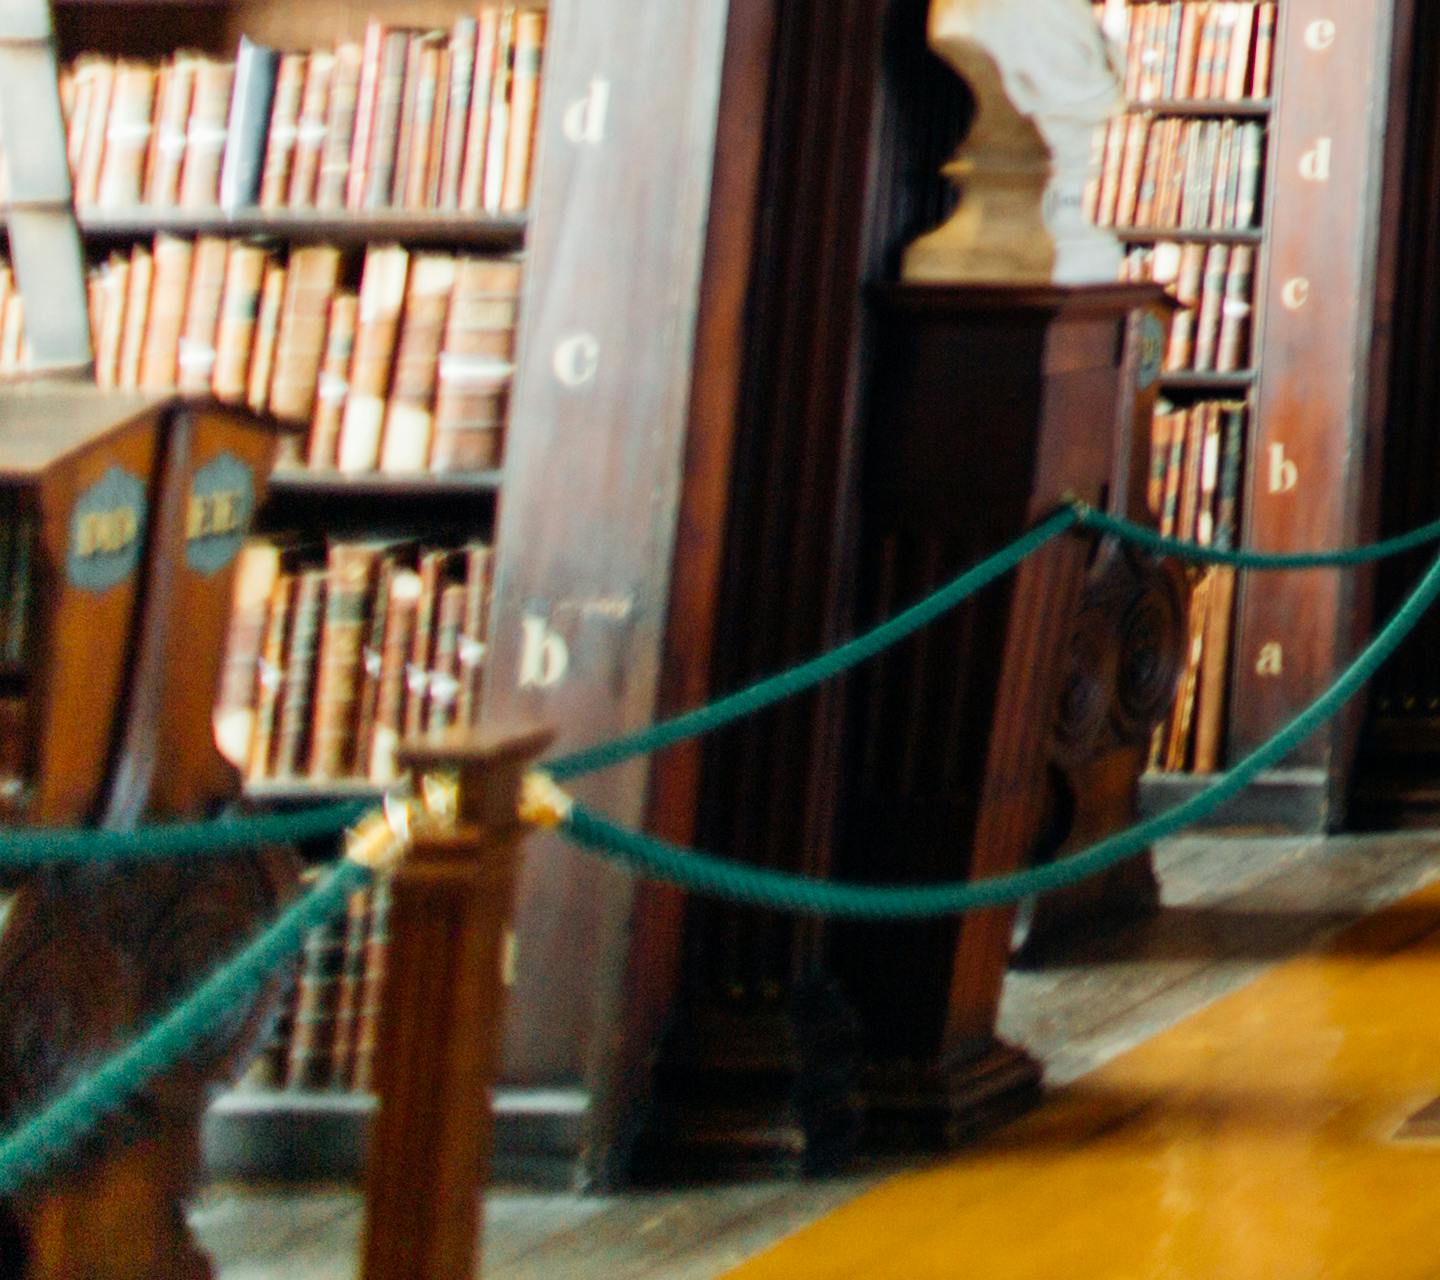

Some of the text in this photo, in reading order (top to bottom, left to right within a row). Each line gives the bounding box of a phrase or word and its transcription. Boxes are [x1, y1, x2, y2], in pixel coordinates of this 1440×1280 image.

[1304, 17, 1335, 50] e
[564, 72, 609, 145] d
[1300, 139, 1331, 180] d
[1282, 276, 1309, 309] c
[553, 333, 598, 388] c
[1268, 443, 1297, 493] b
[520, 616, 568, 686] b
[1257, 641, 1282, 675] a
